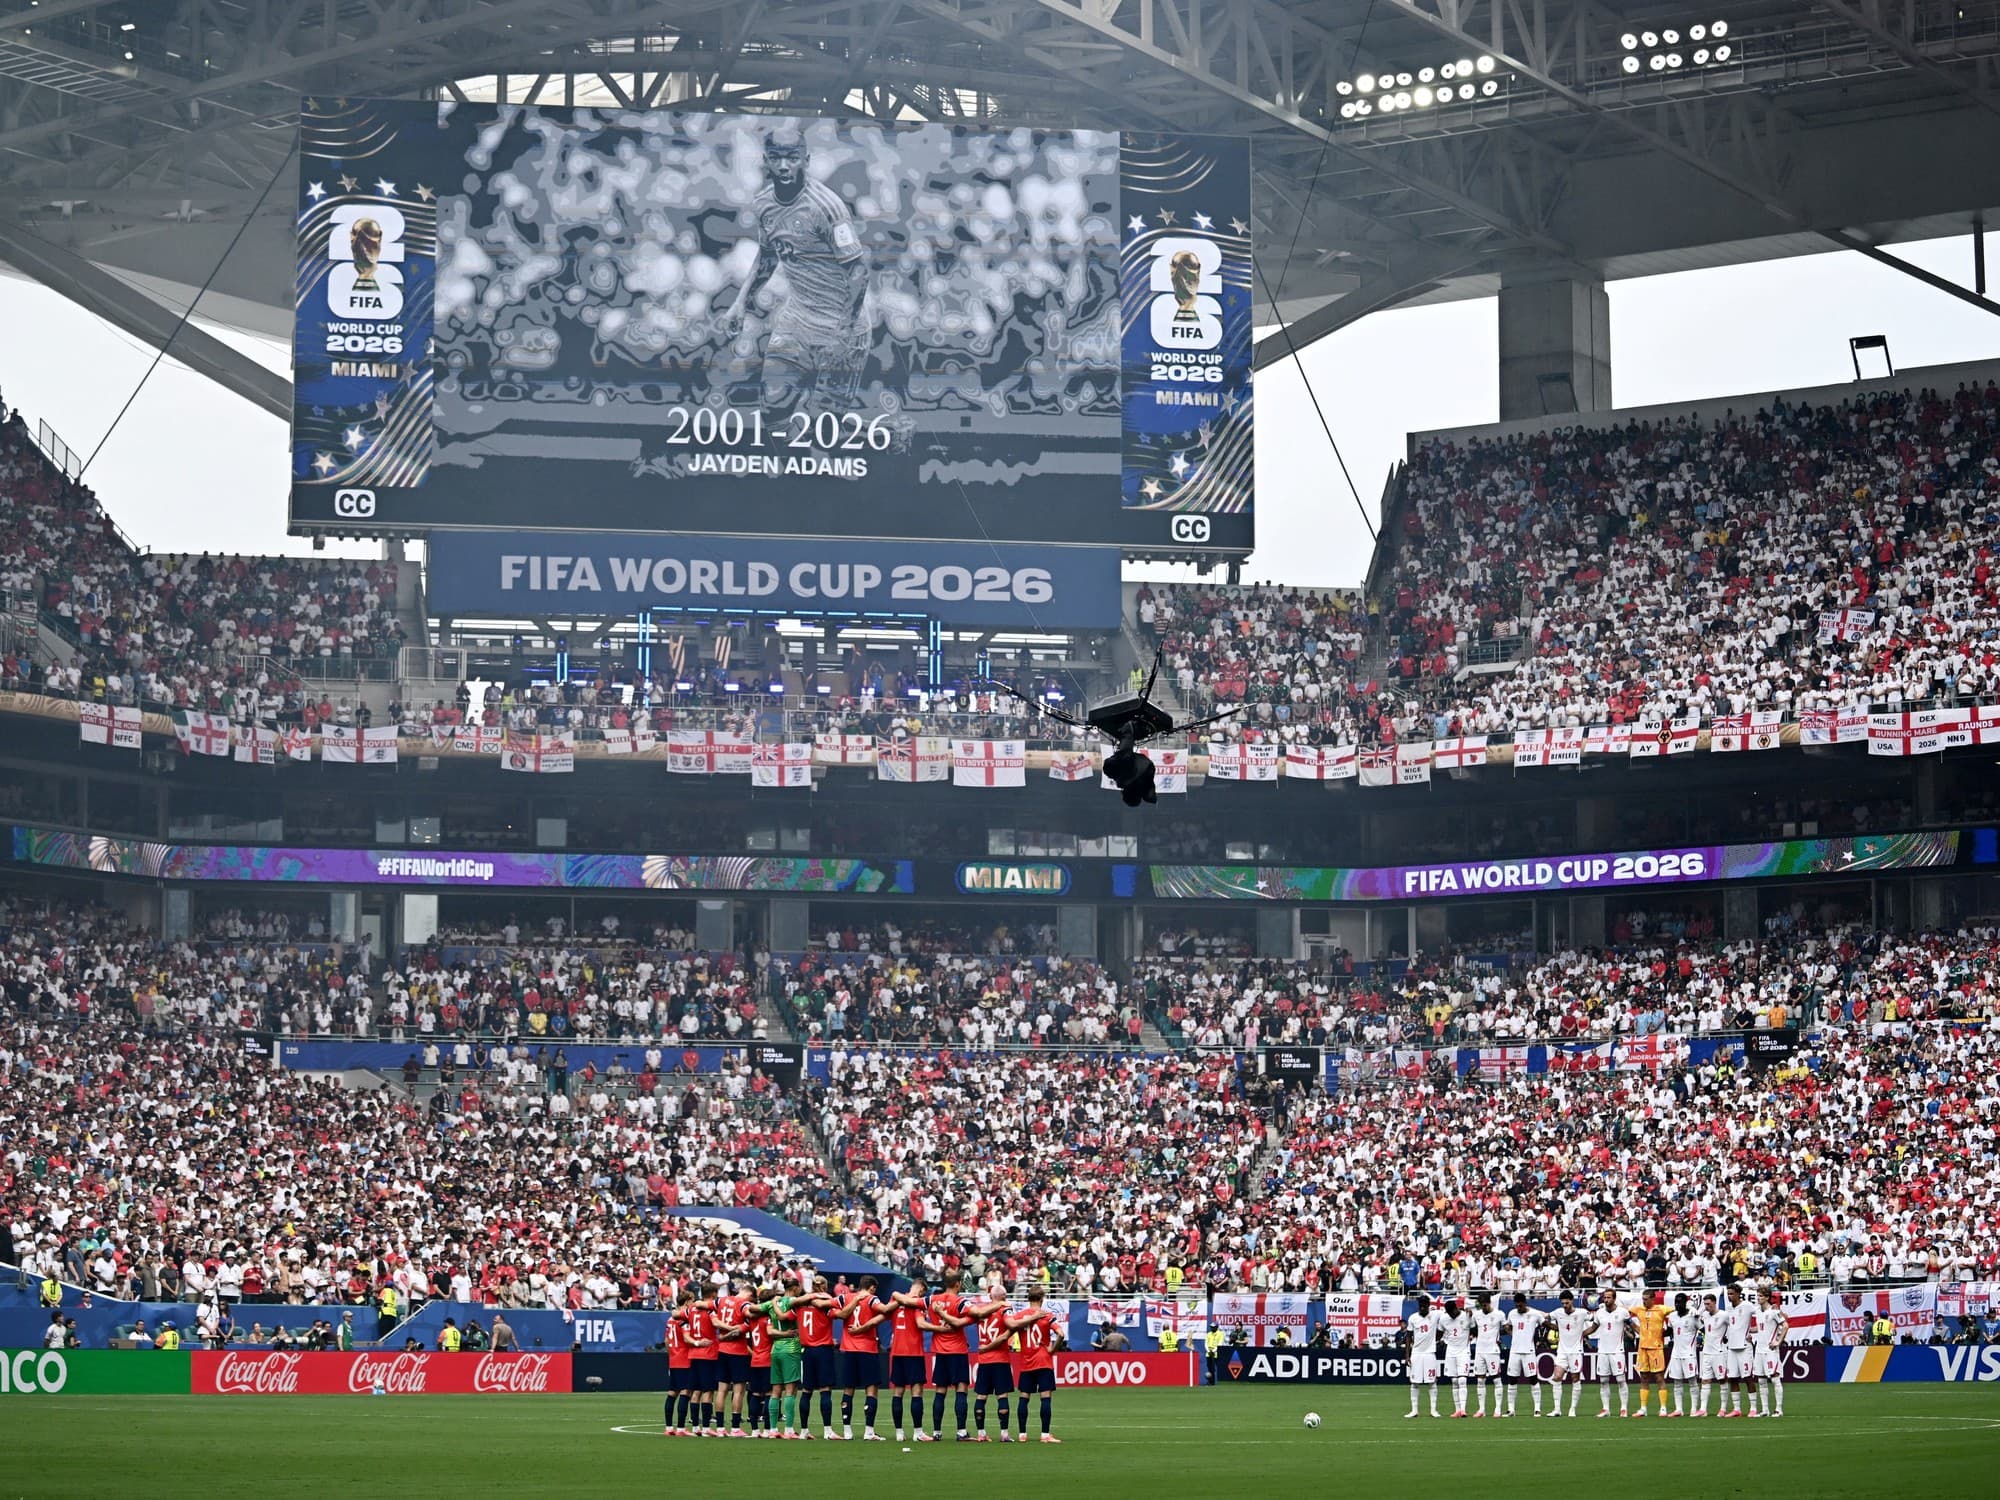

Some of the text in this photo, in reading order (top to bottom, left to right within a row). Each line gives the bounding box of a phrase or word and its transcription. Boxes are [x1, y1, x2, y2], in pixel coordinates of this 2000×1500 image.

[349, 296, 384, 310] FIFA
[327, 322, 403, 336] WORLD CUP
[1171, 326, 1204, 340] FIFA
[325, 335, 403, 354] 2026
[1151, 351, 1224, 366] WORLD CUP
[330, 362, 398, 379] MIAMI
[1150, 364, 1224, 383] 2026
[1155, 390, 1220, 408] MIAMI
[666, 407, 892, 453] 2001-2026
[688, 454, 868, 477] JAYDEN ADAMS
[338, 493, 373, 514] CC
[1175, 519, 1207, 539] CC
[500, 555, 1053, 604] FIFA WORLD CUP 2026
[1645, 719, 1687, 730] WOLVES
[1838, 718, 1853, 726] CITY
[1919, 714, 1936, 723] DEX
[1754, 724, 1778, 734] WOLVES
[1958, 720, 1994, 730] RAUNDS
[114, 733, 134, 743] NFFC
[483, 728, 499, 736] ST4
[1875, 730, 1912, 738] RUNNING
[1914, 727, 1937, 736] MARE
[324, 738, 396, 747] BRISTOL ROVERS
[455, 740, 475, 749] CM2
[1518, 741, 1577, 752] ARSENAL FC
[1674, 741, 1689, 749] WE
[1918, 740, 1937, 749] 2026
[683, 745, 725, 754] BRENTFORD
[1373, 760, 1402, 768] FULHAM
[1518, 754, 1537, 762] 1886
[1173, 766, 1185, 774] FC
[378, 858, 494, 880] #FIFAWorldCup
[1405, 853, 1705, 893] FIFA WORLD CUP 2026
[965, 867, 1062, 890] MIAMI
[1329, 1305, 1355, 1313] Mate
[1216, 1315, 1304, 1325] MIDDLESBROUGH
[1328, 1316, 1400, 1326] Jimmy Lockett
[1832, 1310, 1934, 1332] BLACOOL FC
[574, 1319, 616, 1343] FIFA
[1453, 1328, 1458, 1337] 2
[1565, 1323, 1570, 1331] 4
[1024, 1323, 1043, 1348] 10
[1249, 1355, 1309, 1379] ADI
[1490, 1362, 1496, 1370] 5
[1574, 1359, 1579, 1367] 4
[215, 1351, 303, 1393] Coca-Cola
[348, 1353, 431, 1392] Coca-Cola
[473, 1353, 552, 1392] Coca-Cola
[1053, 1354, 1146, 1385] Lenovo
